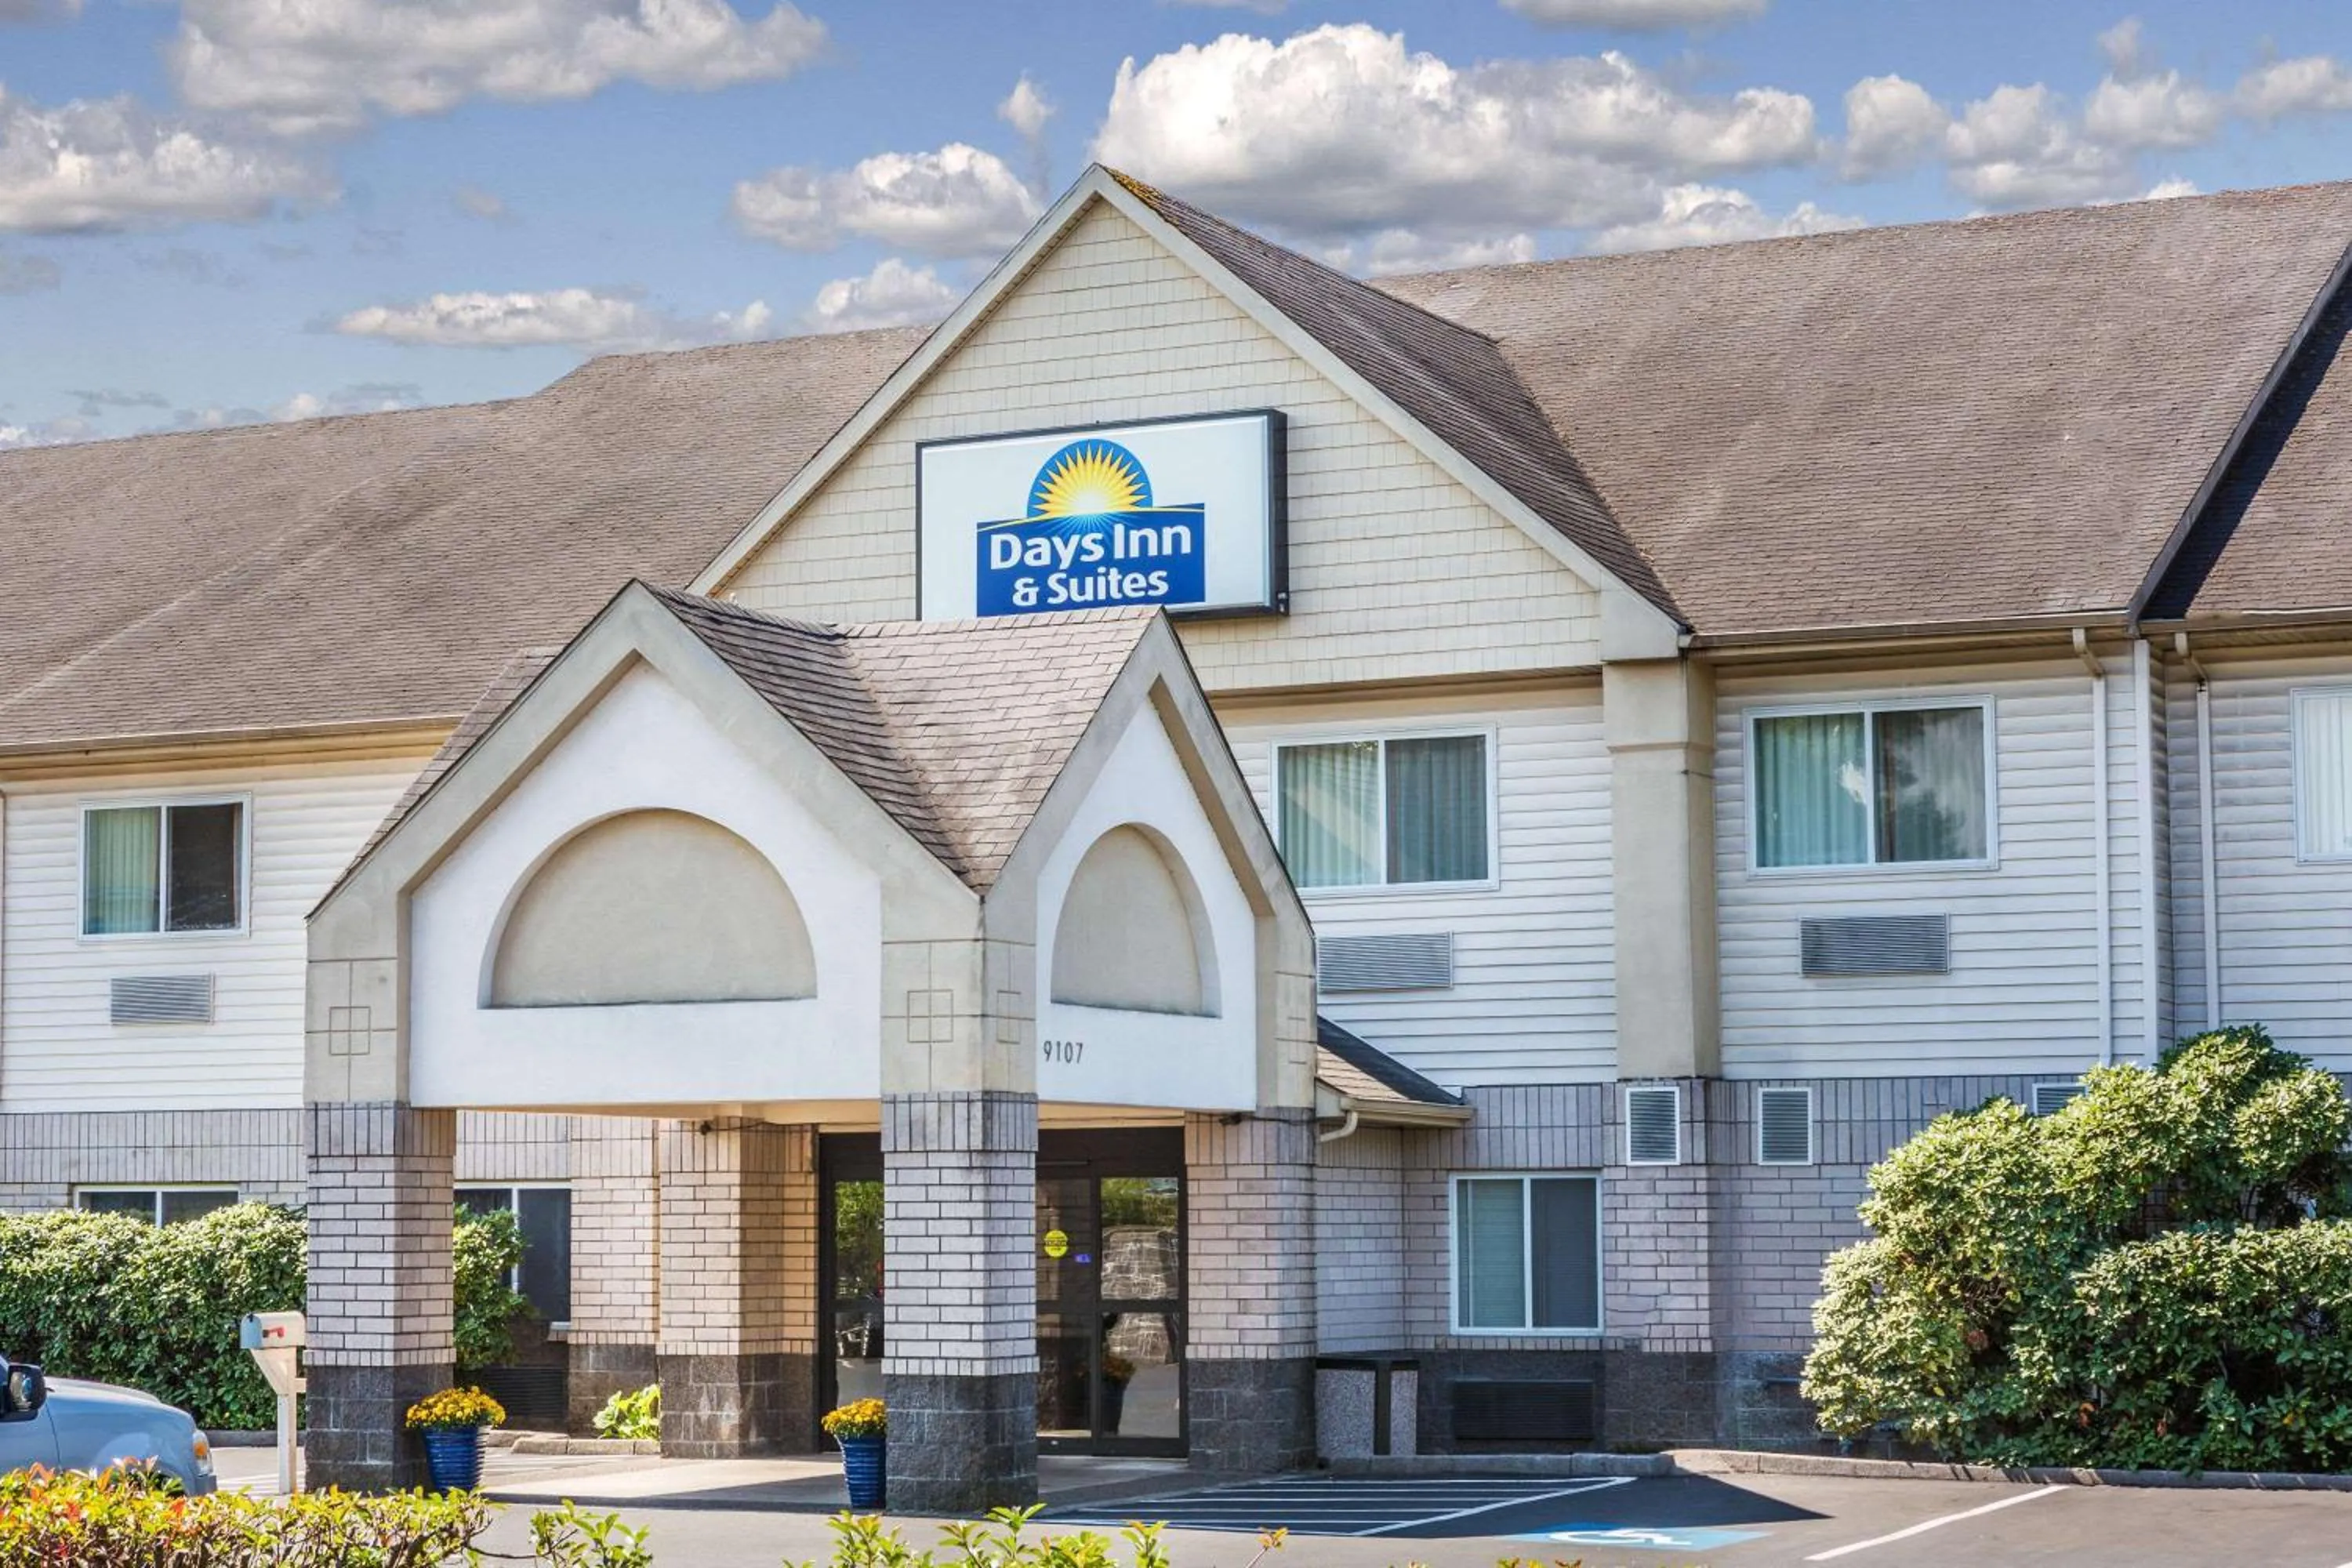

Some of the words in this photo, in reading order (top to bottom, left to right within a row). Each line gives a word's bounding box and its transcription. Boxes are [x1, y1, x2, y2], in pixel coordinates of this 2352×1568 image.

[990, 533, 1105, 570] Days
[1114, 524, 1191, 559] Inn
[1012, 577, 1039, 606] &
[1047, 567, 1168, 603] Suites
[1044, 1040, 1083, 1063] 9107
